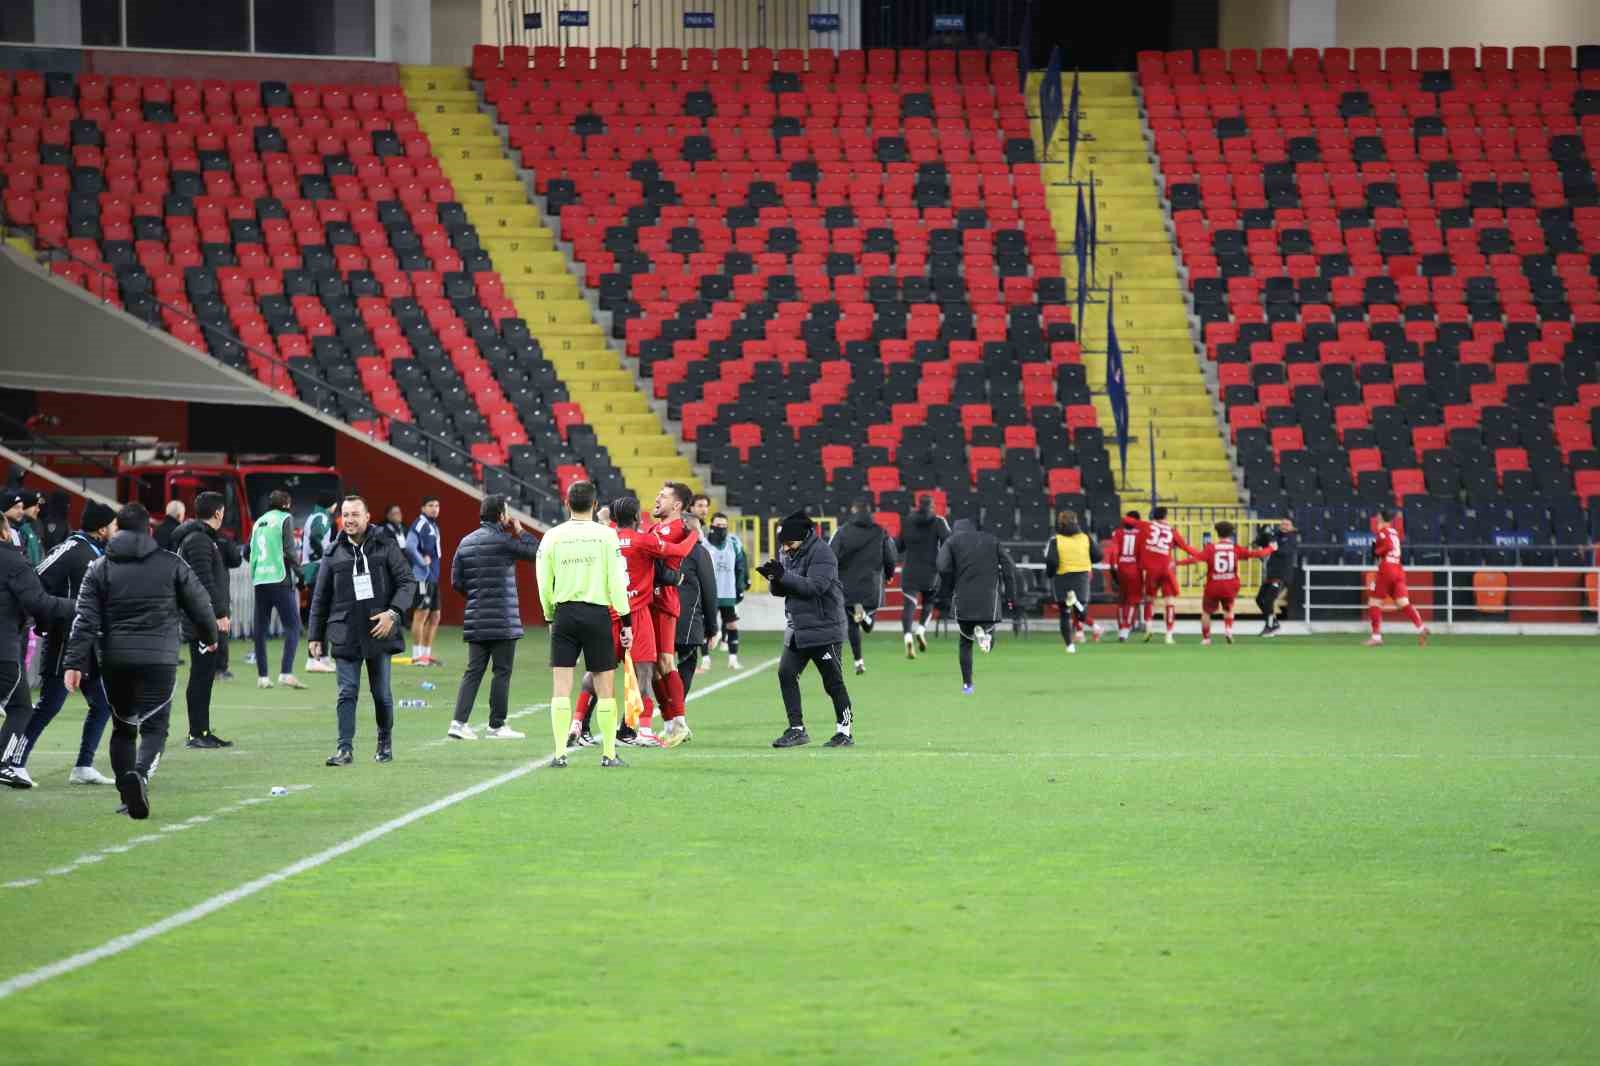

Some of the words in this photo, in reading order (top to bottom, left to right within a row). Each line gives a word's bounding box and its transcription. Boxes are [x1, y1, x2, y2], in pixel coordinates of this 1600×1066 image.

[1123, 534, 1136, 556] 11
[1145, 523, 1173, 547] 32
[1214, 550, 1235, 573] 61
